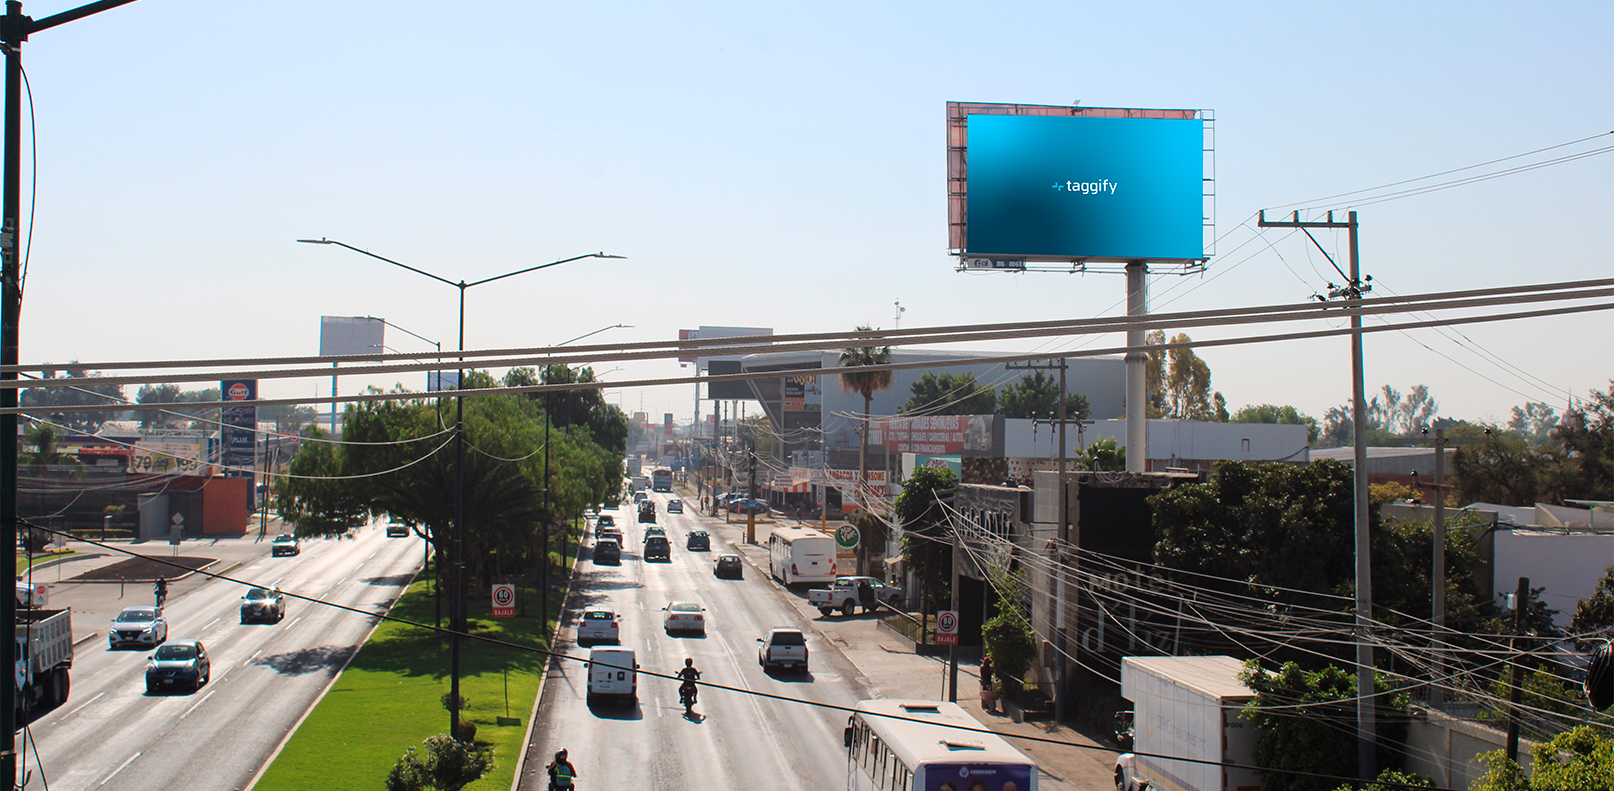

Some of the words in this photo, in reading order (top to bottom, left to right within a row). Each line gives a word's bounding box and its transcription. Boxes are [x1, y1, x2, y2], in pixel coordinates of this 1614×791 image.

[1066, 179, 1117, 194] taggify
[499, 590, 508, 598] 60
[943, 616, 952, 625] 60
